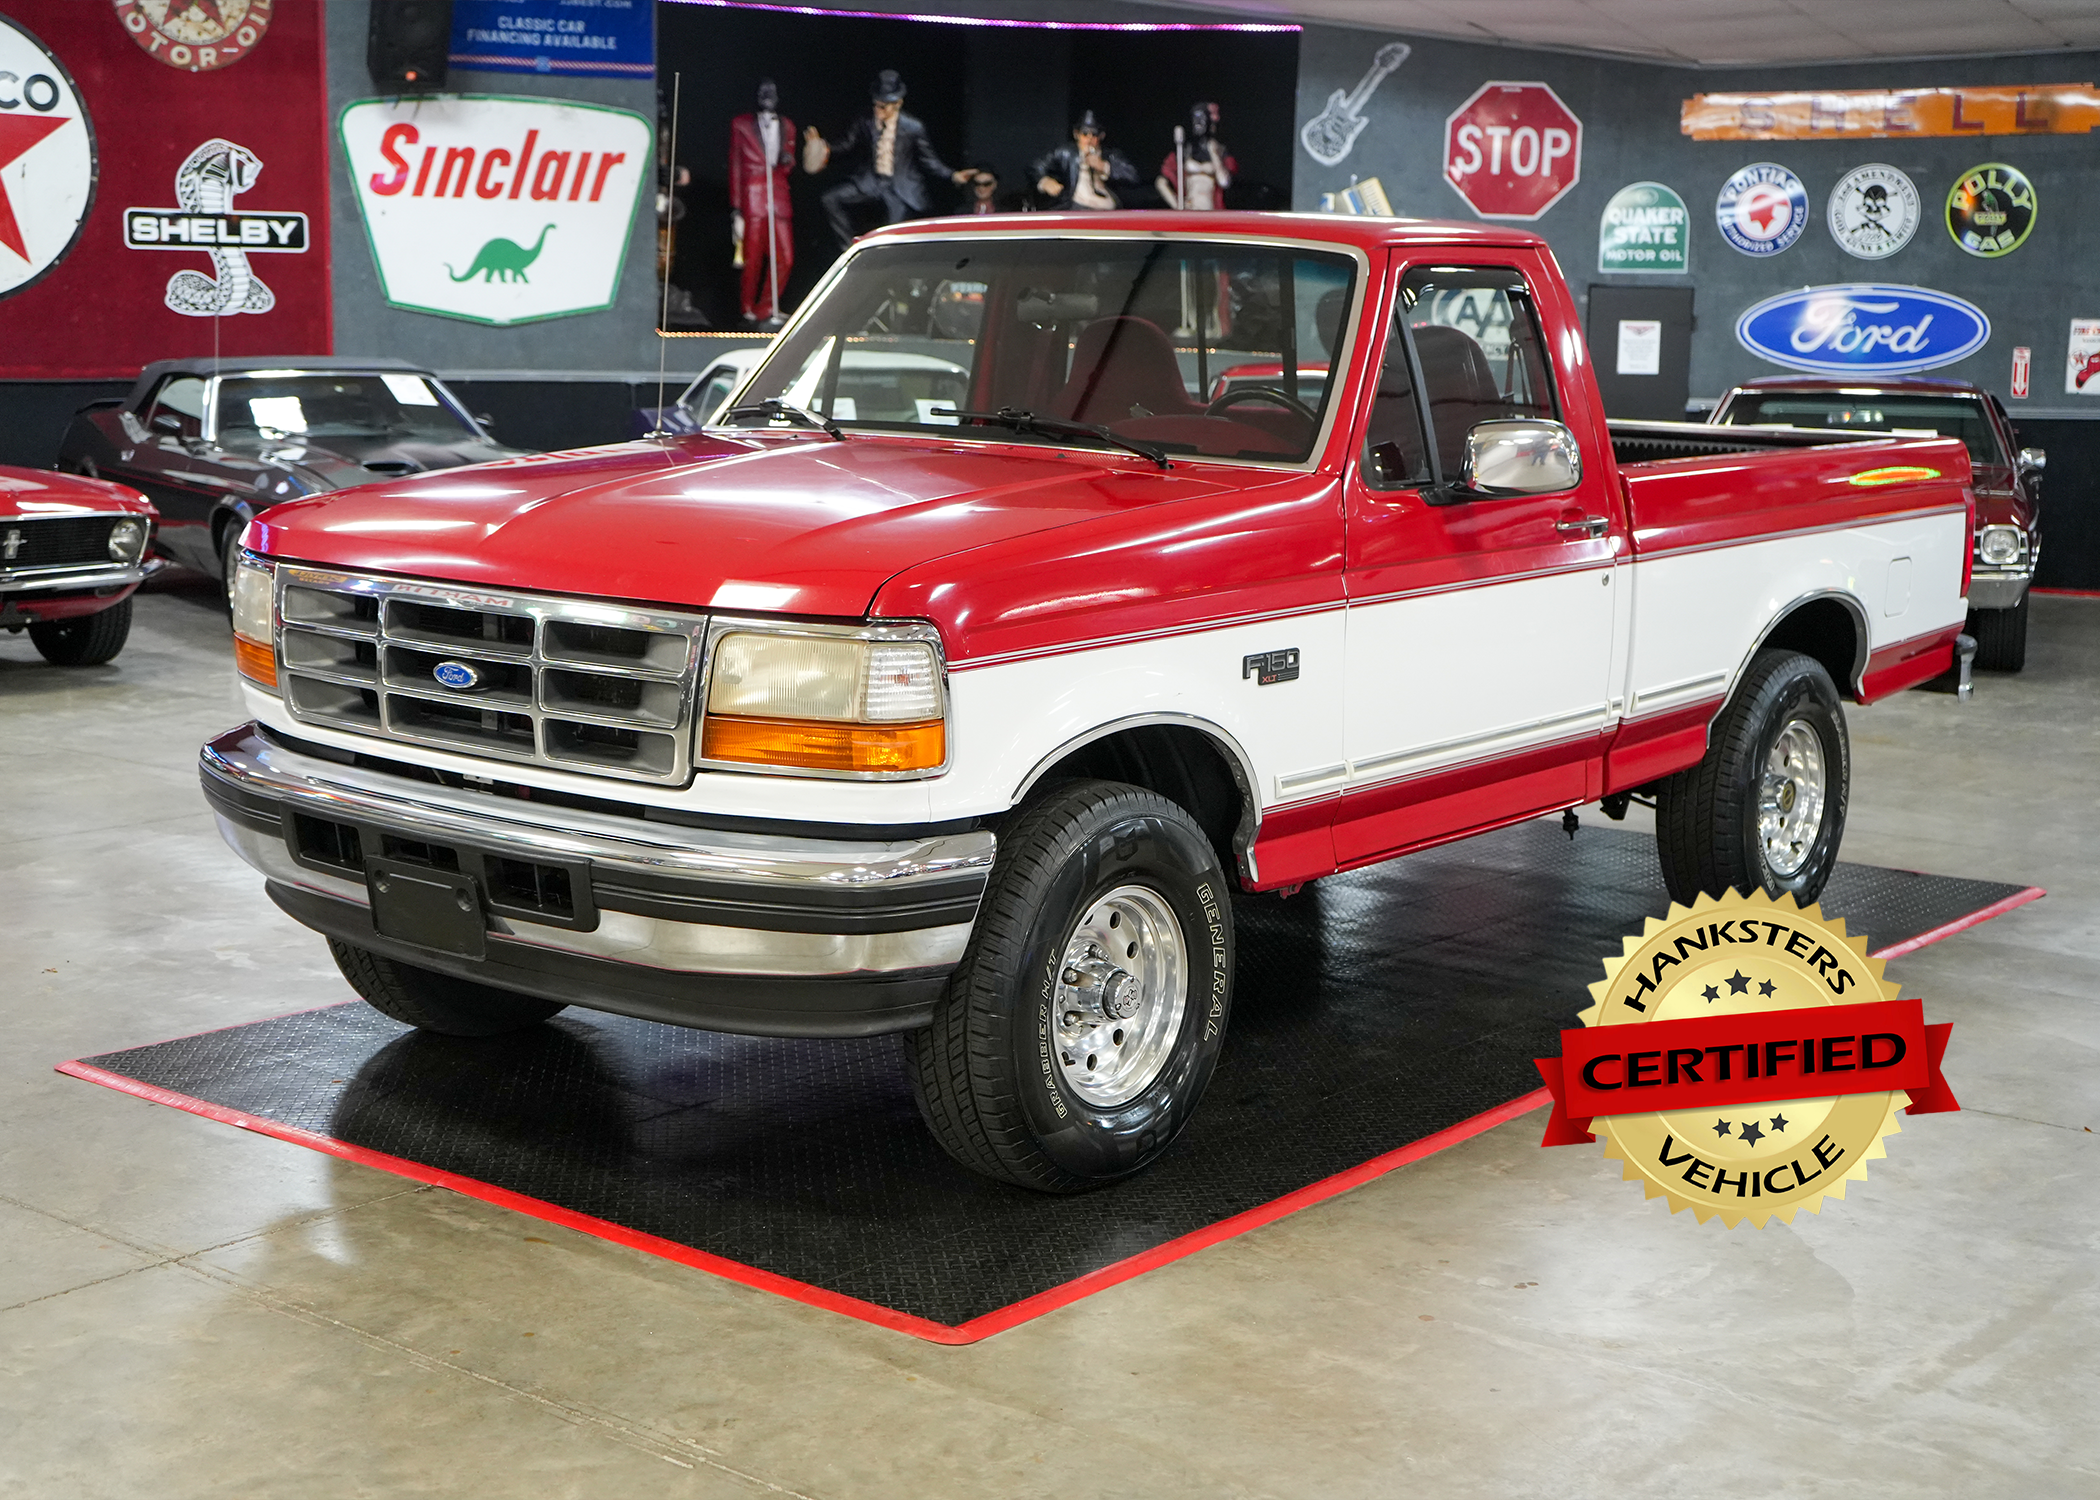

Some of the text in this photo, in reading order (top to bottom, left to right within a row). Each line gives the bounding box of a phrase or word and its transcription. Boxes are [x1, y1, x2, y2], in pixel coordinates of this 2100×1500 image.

[467, 29, 617, 49] FINANCING AVAILABLE
[498, 16, 586, 33] CLASSIC CAR
[1740, 92, 2049, 132] SHELL
[370, 123, 626, 202] Sinclair
[1454, 124, 1572, 177] STOP
[1721, 167, 1801, 202] PONTIAC
[1952, 169, 2032, 211] POLLY
[132, 216, 298, 245] SHELBY
[1608, 206, 1684, 226] QUAKER
[1614, 226, 1678, 245] STATE
[1963, 229, 2015, 252] GAS
[1605, 248, 1684, 262] MOTOR OIL
[1790, 299, 1934, 354] Ford
[441, 666, 465, 683] Ford
[1261, 674, 1277, 684] XLT
[1197, 881, 1226, 1042] GENERAL
[1037, 948, 1068, 1120] GRABBER H/T
